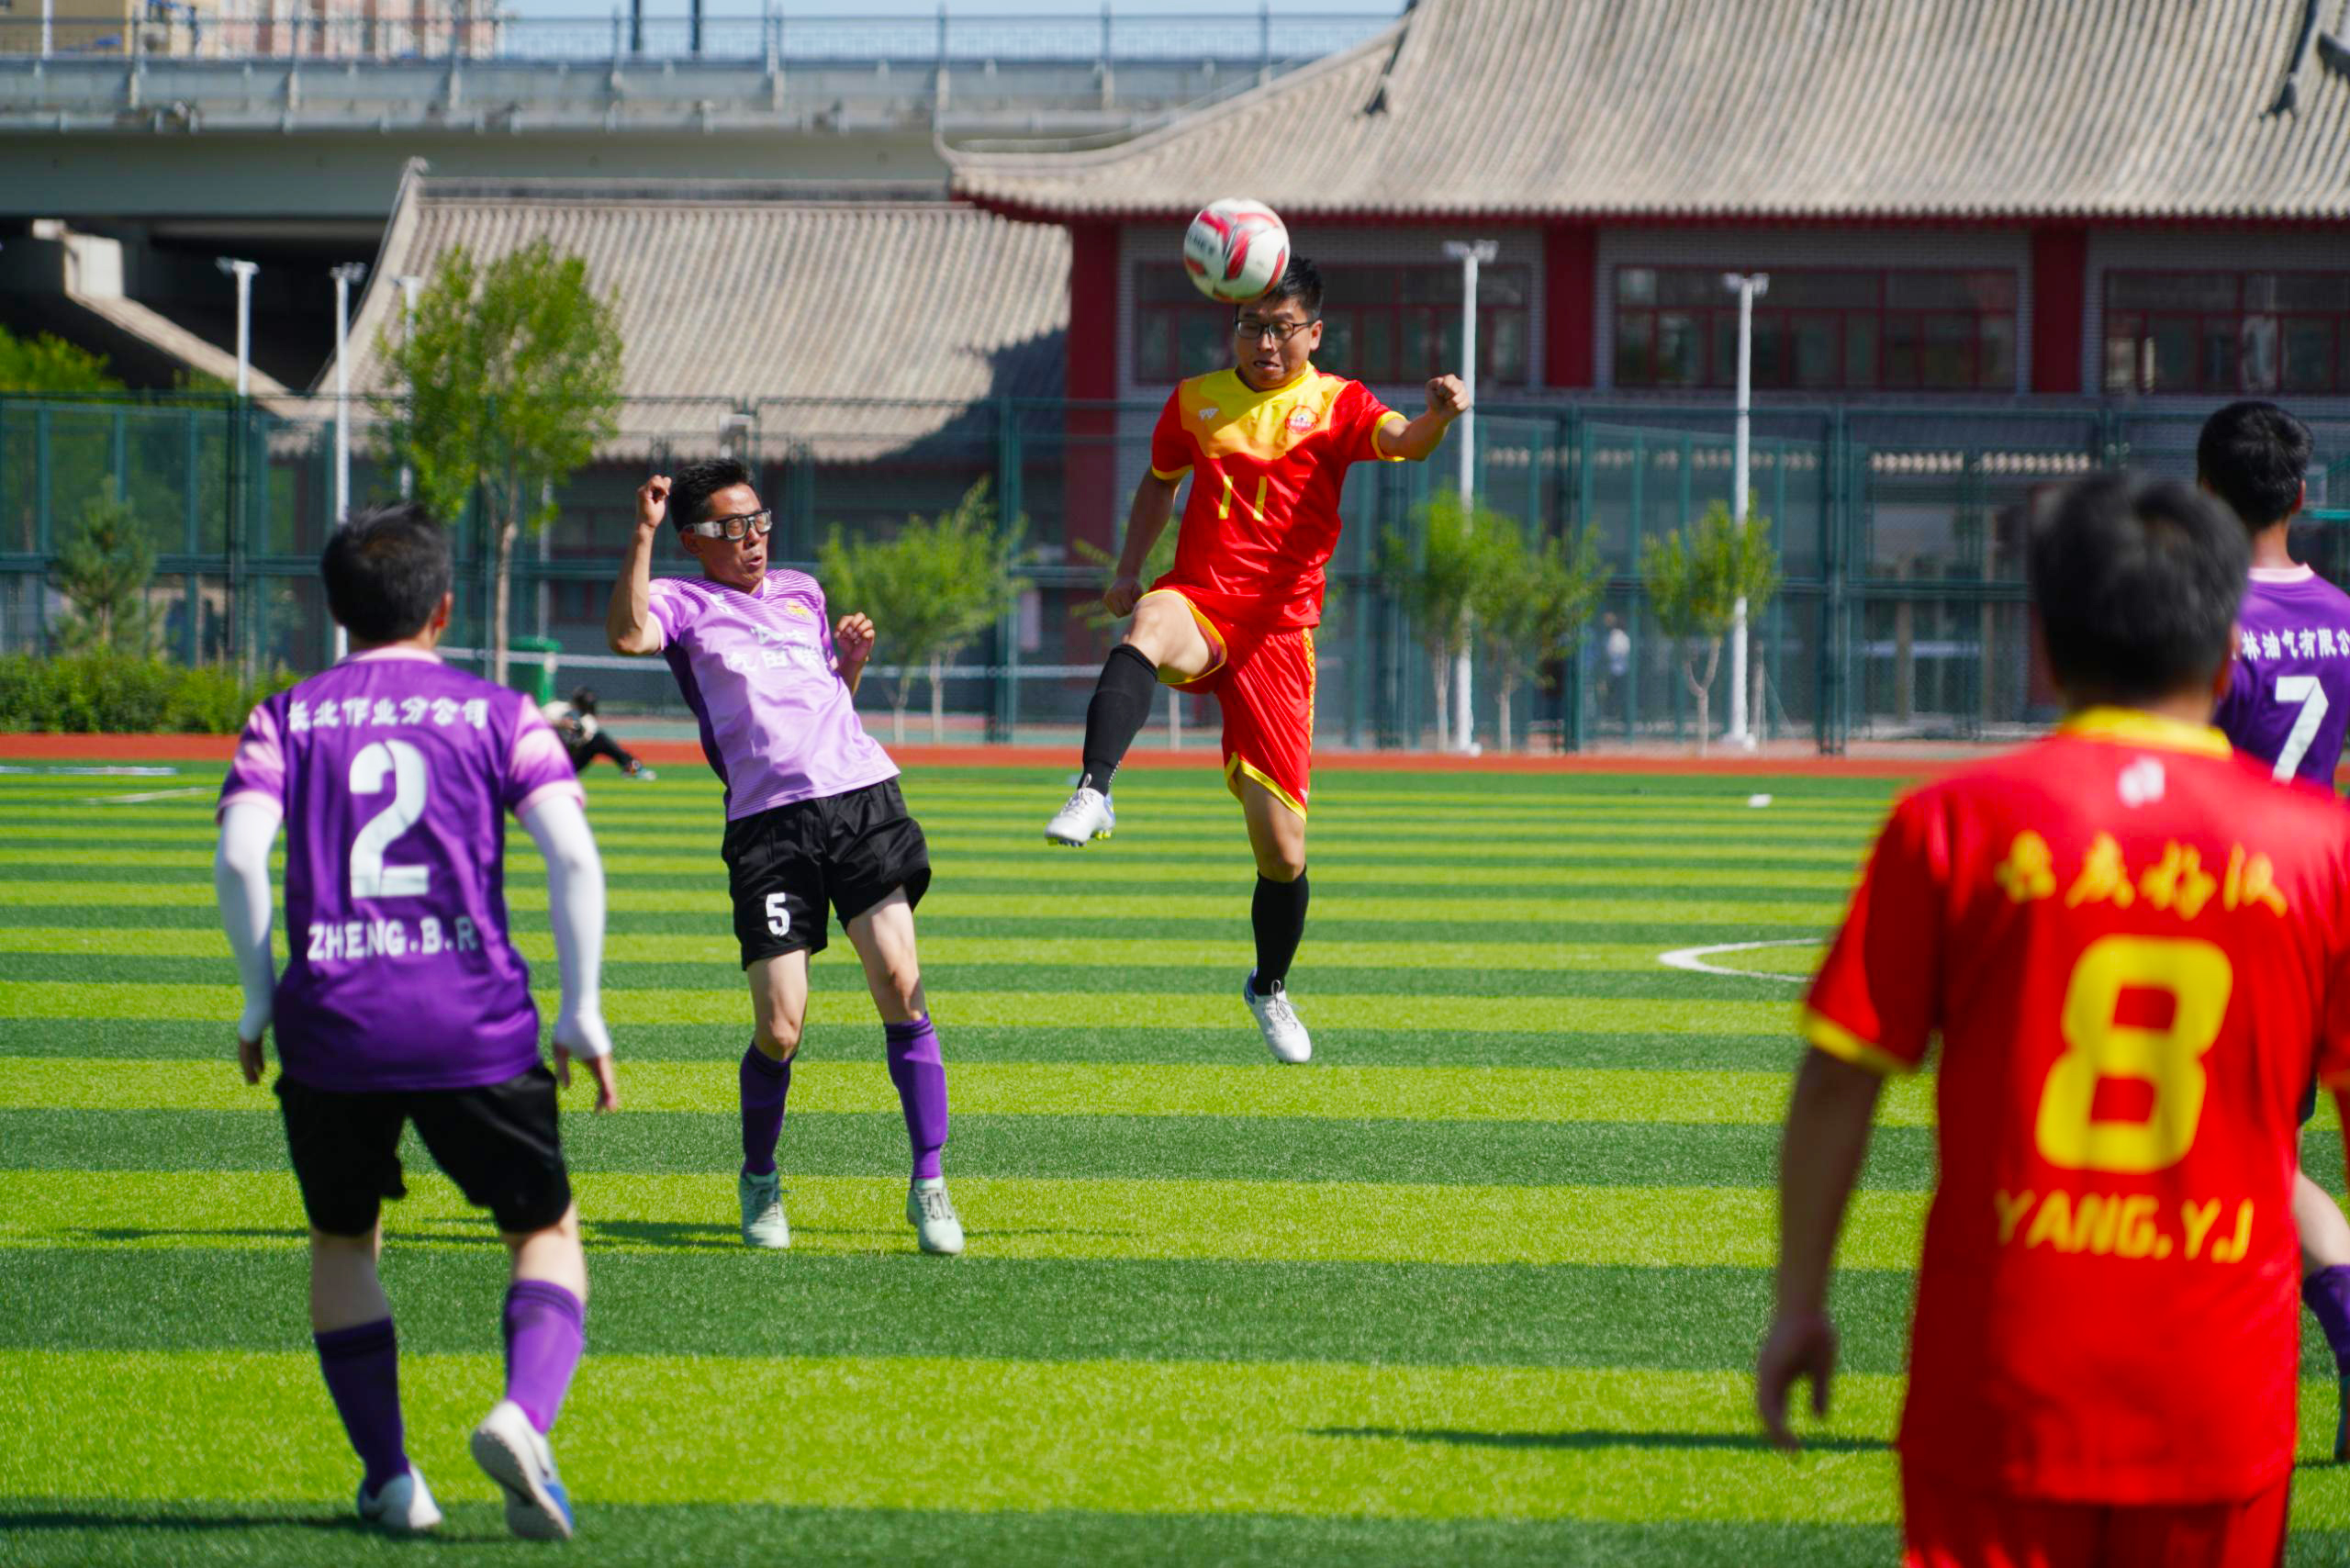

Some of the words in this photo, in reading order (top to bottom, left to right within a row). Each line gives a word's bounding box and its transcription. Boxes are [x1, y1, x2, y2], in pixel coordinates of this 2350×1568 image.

[1218, 475, 1268, 521] 11
[2232, 625, 2350, 660] 林油气有限公
[287, 696, 488, 731] 长北作业分公司
[2273, 676, 2329, 785] 7
[350, 738, 430, 898] 2
[765, 892, 789, 935] 5
[307, 917, 479, 960] ZHENG.B.R
[2034, 934, 2232, 1173] 8
